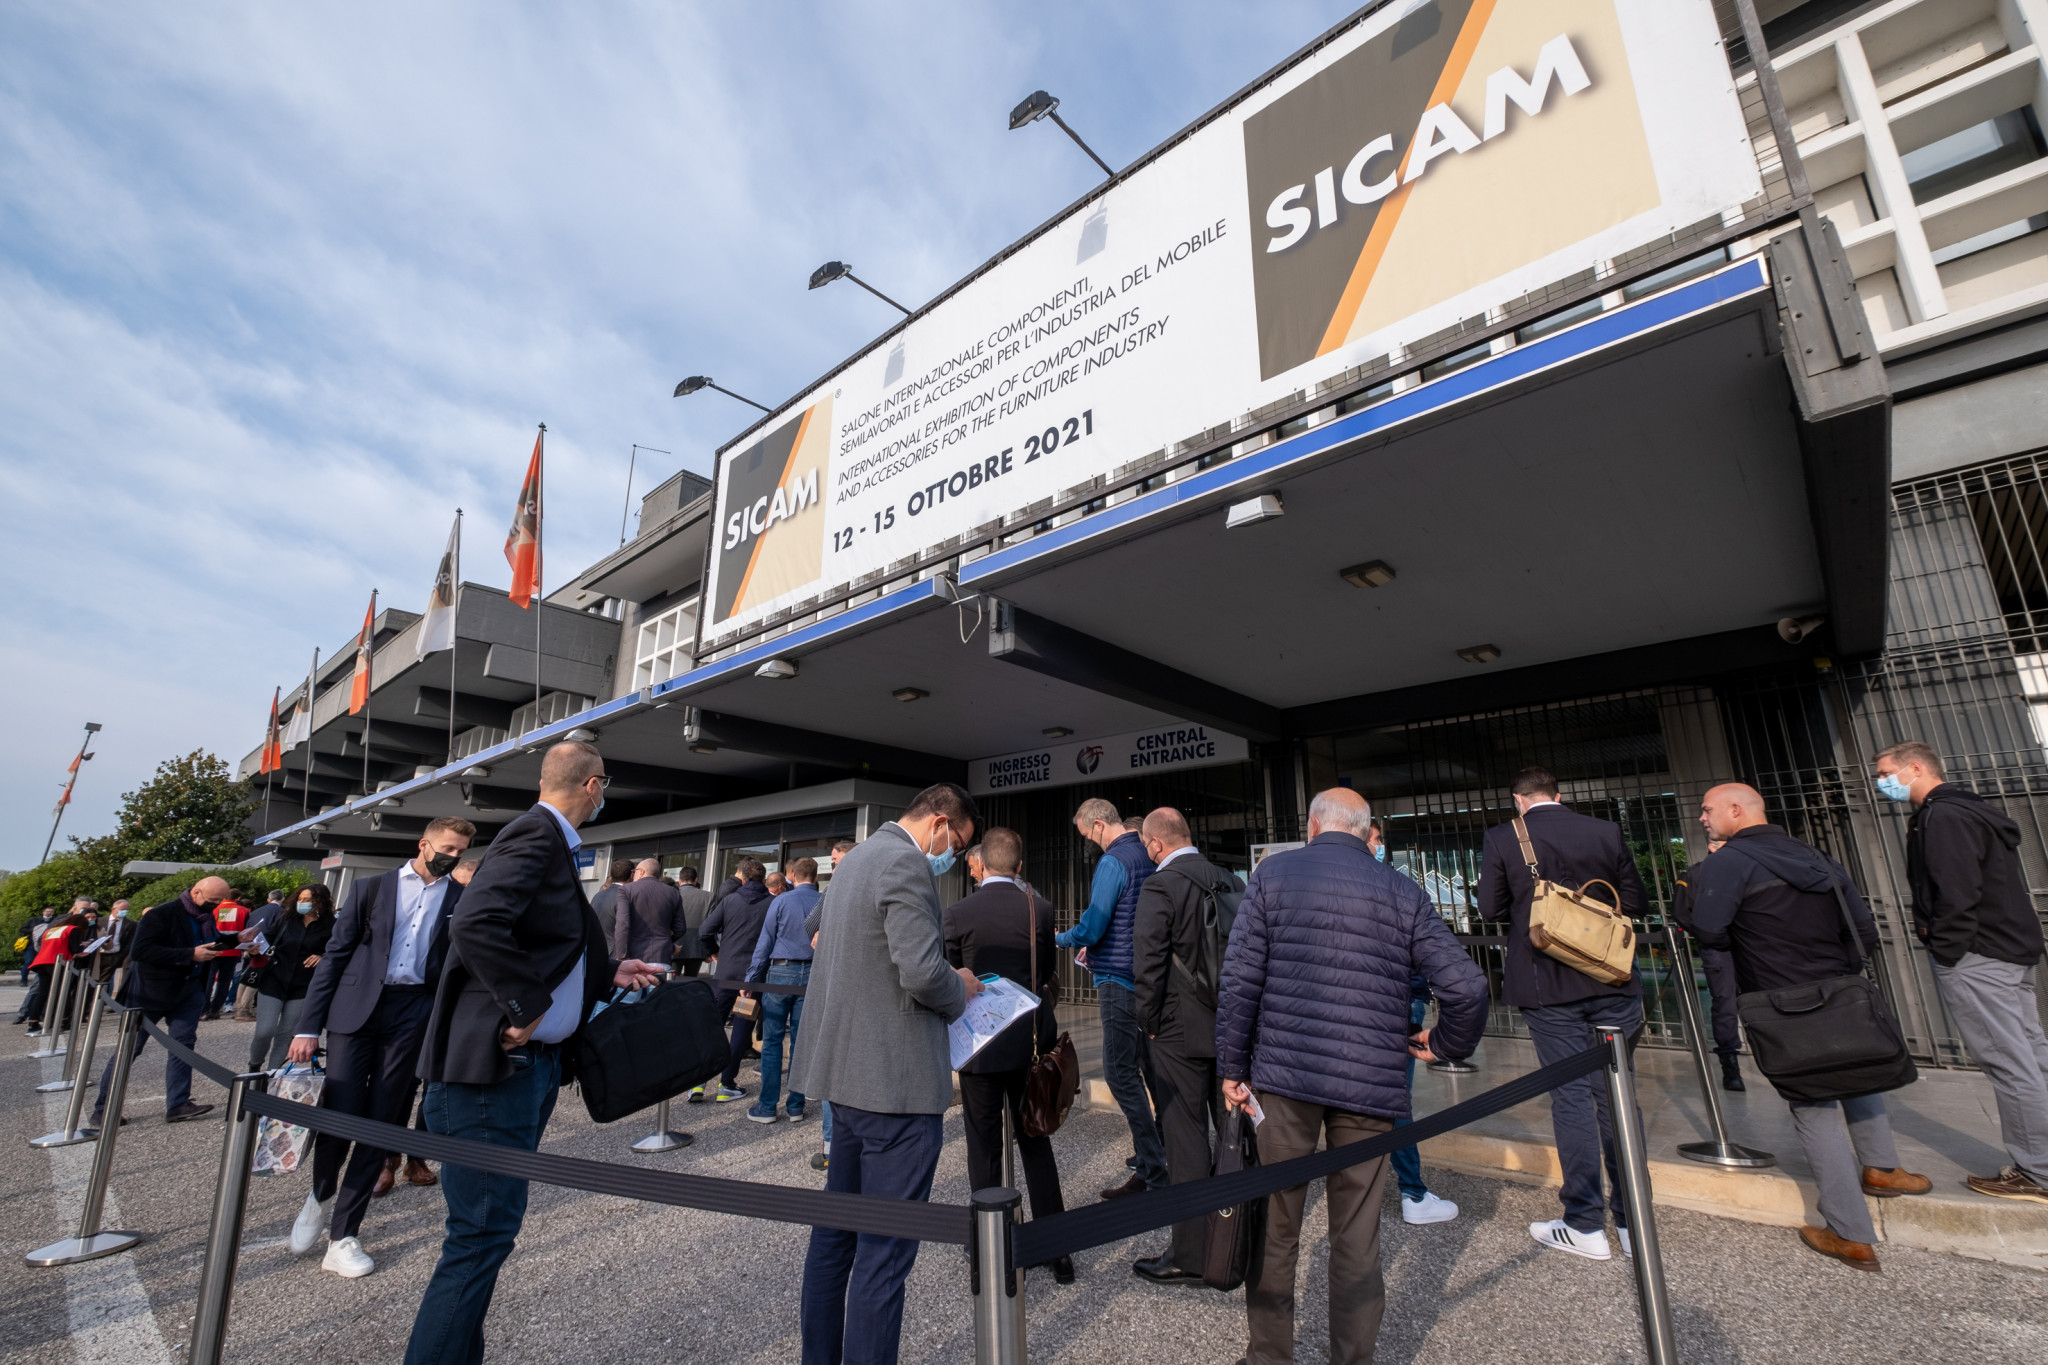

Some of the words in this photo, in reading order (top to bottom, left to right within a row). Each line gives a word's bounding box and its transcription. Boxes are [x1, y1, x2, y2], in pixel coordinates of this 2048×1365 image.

[1265, 32, 1592, 254] SICAM
[836, 483, 861, 505] AND
[862, 439, 939, 492] ACCESSORIES
[941, 423, 968, 450] FOR
[972, 408, 996, 434] THE
[999, 363, 1080, 419] FURNITURE
[1083, 314, 1170, 376] INDUSTRY
[837, 428, 922, 486] INTERNATIONAL
[924, 387, 995, 439] EXHIBITION
[998, 373, 1019, 397] OF
[1022, 306, 1141, 384] COMPONENTS
[839, 406, 912, 457] SEMILAVORATI
[913, 398, 921, 414] E
[922, 355, 993, 409] ACCESSORI
[996, 340, 1020, 366] PER
[1121, 263, 1152, 293] DEL
[1156, 218, 1228, 273] MOBILE
[841, 403, 882, 438] SALONE
[883, 340, 984, 413] INTERNAZIONALE
[987, 276, 1094, 348] COMPONENTI,
[725, 467, 819, 551] SICAM
[833, 527, 853, 553] 12
[874, 505, 895, 533] 15
[907, 447, 1014, 517] OTTOBRE
[1023, 408, 1094, 465] 2021
[988, 752, 1051, 775] INGRESSO
[989, 768, 1051, 789] CENTRALE
[1130, 741, 1216, 769] ENTRANCE
[1136, 726, 1208, 751] CENTRAL
